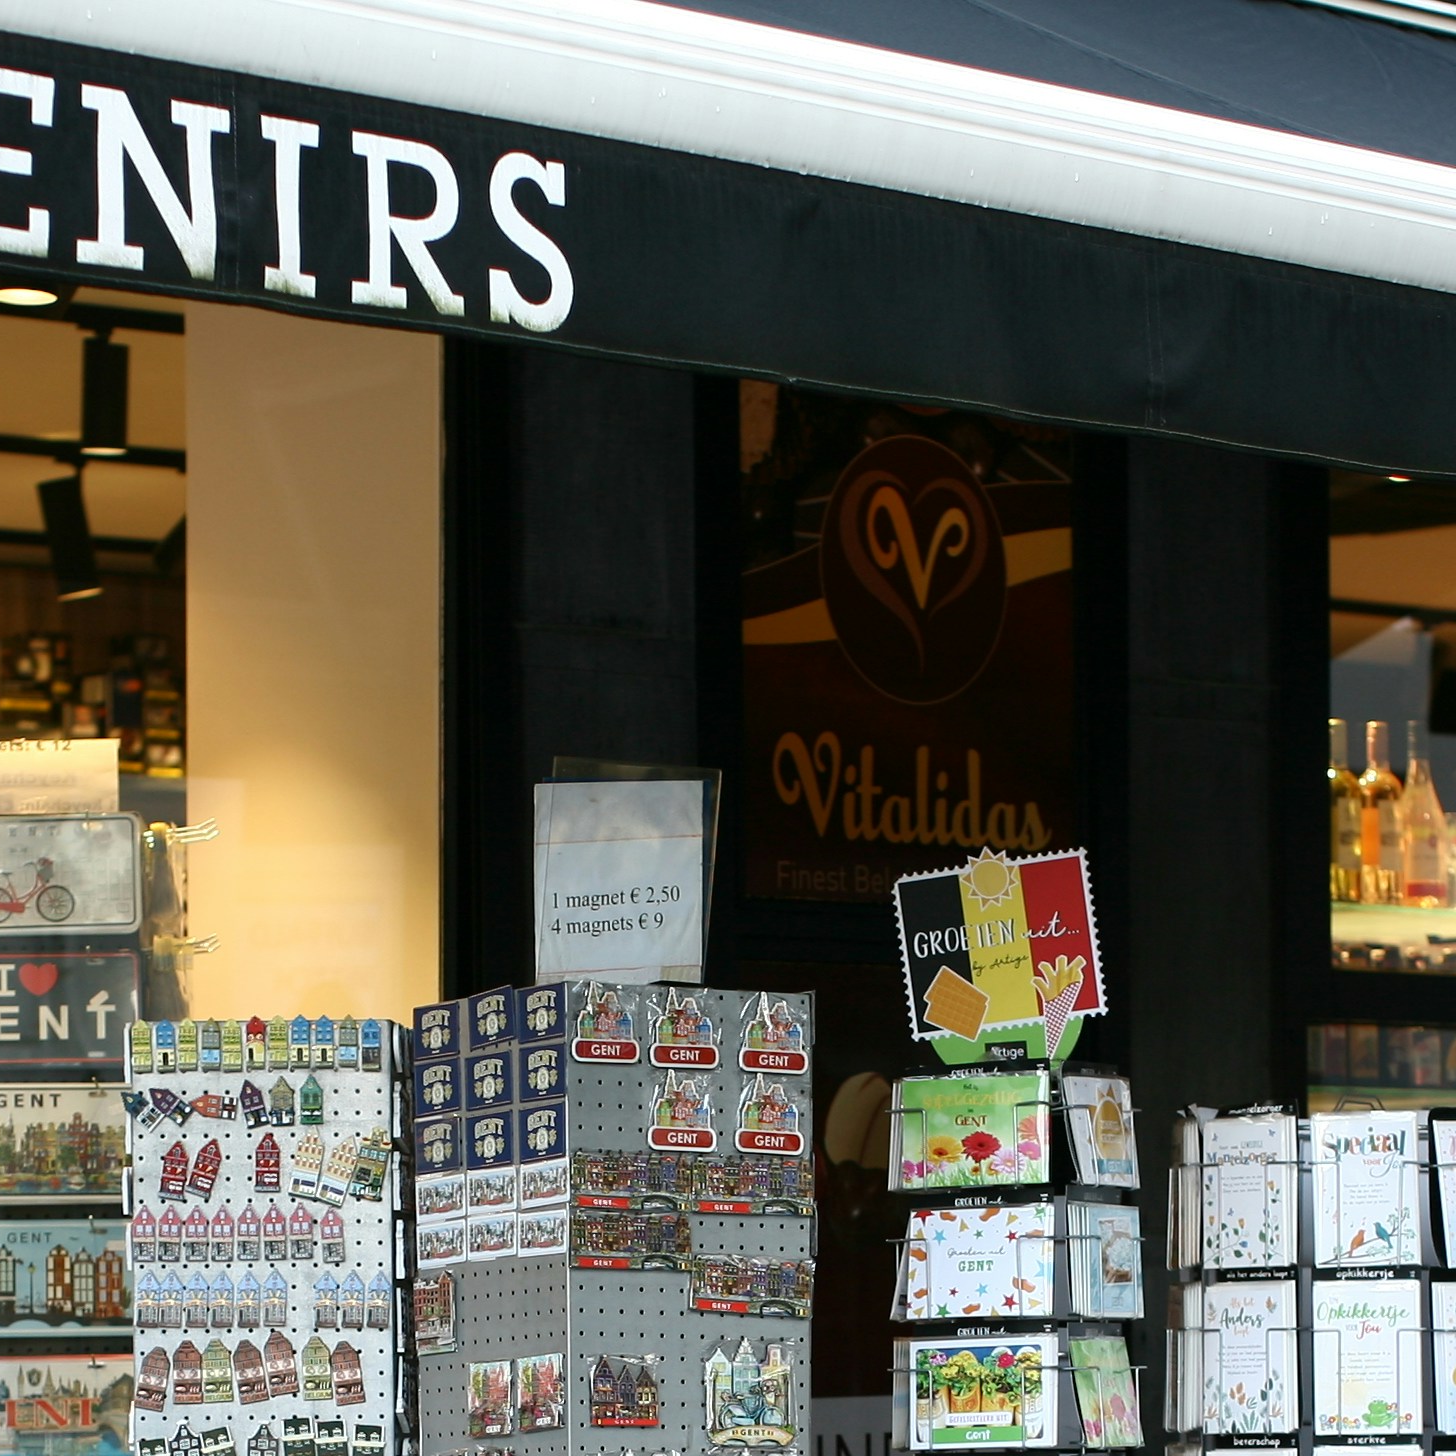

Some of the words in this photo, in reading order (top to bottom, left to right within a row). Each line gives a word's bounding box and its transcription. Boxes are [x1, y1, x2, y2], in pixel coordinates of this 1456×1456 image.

[773, 732, 1051, 851] Vitalidas
[776, 861, 847, 893] Finest
[551, 891, 560, 909] 1
[566, 889, 626, 912] magnet
[630, 888, 642, 905] €
[645, 885, 681, 906] 2,50
[550, 918, 562, 936] 4
[566, 914, 634, 937] magnets
[638, 913, 649, 930] €
[653, 912, 664, 929] 9
[590, 1043, 622, 1057] GENT
[669, 1048, 701, 1062] GENT
[758, 1054, 790, 1068] GENT
[667, 1130, 699, 1145] GENT
[754, 1134, 786, 1149] GENT
[1321, 1126, 1407, 1164] Speciaal
[6, 1231, 54, 1246] GENT
[958, 1259, 994, 1273] GENT
[1336, 1268, 1395, 1280] opkikkertje
[1219, 1307, 1265, 1330] Anders
[1316, 1303, 1410, 1328] Opkikkertje
[739, 1428, 766, 1438] GENT
[1347, 1435, 1387, 1446] sterkte
[1233, 1435, 1281, 1449] beterschap
